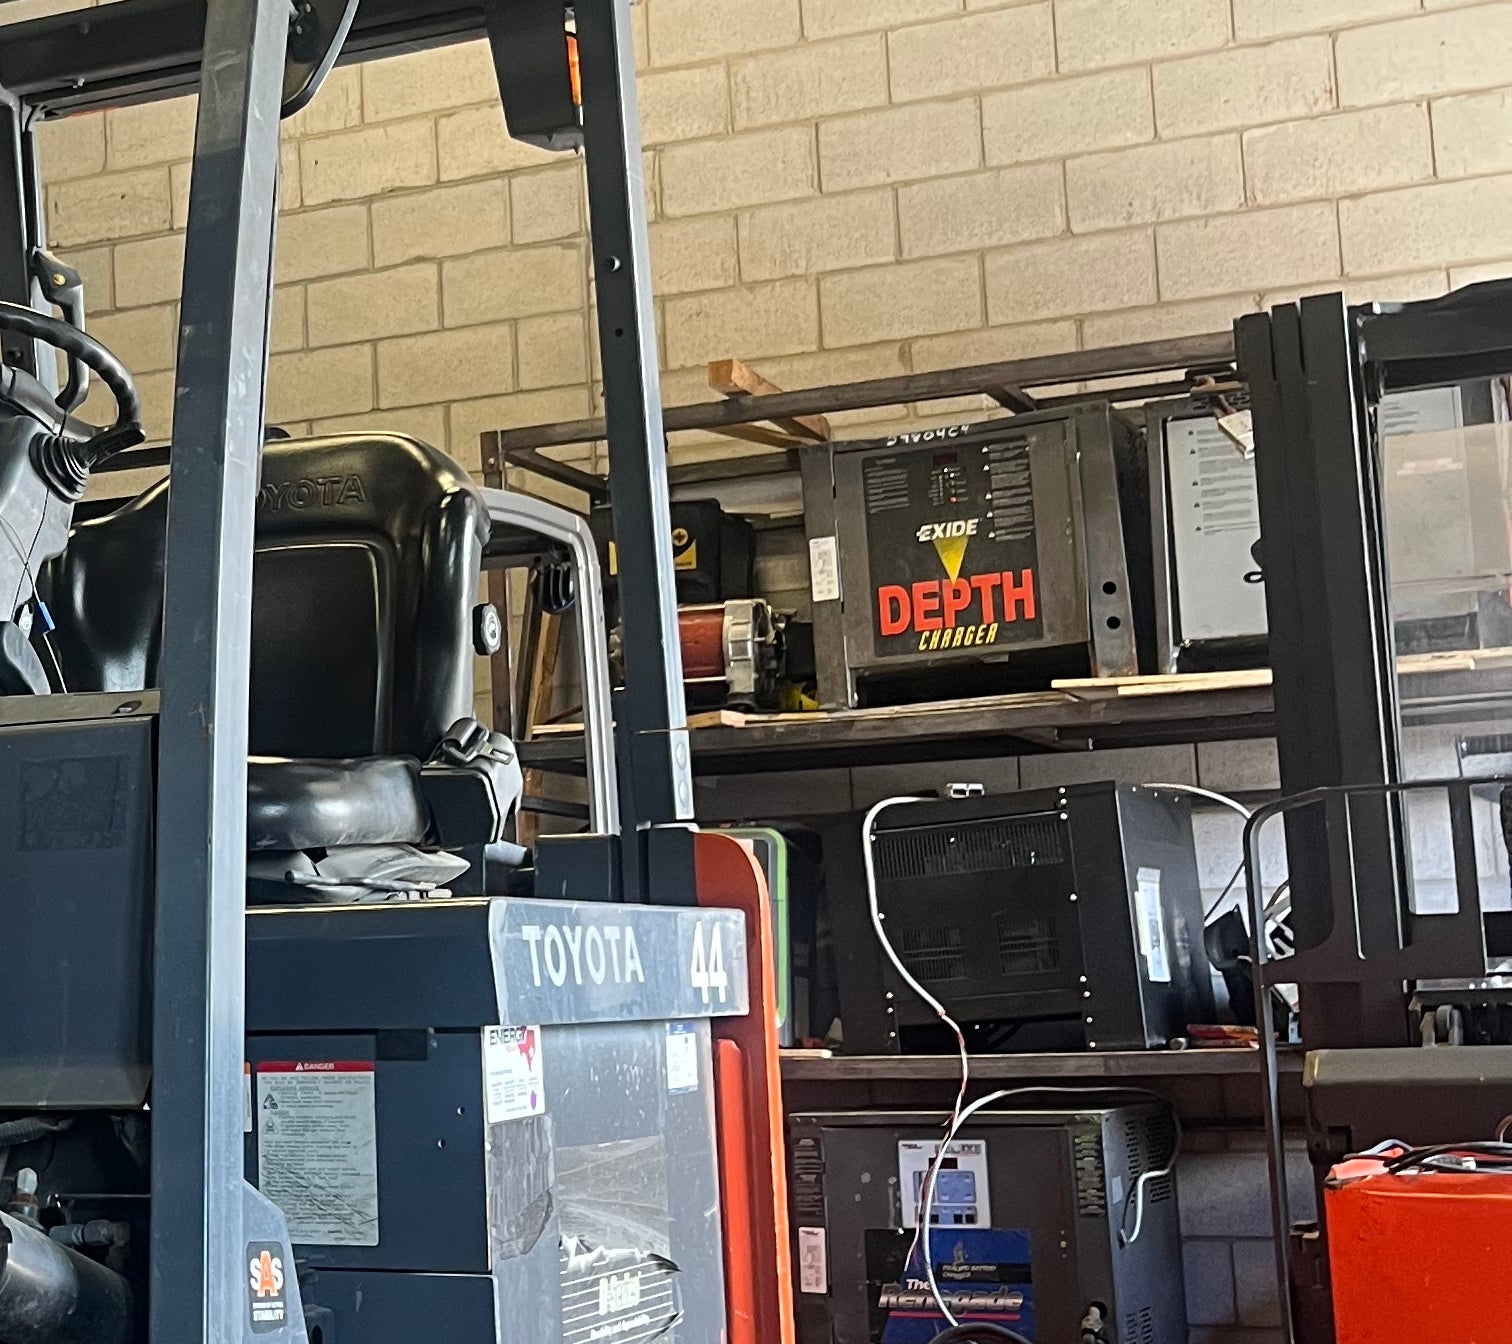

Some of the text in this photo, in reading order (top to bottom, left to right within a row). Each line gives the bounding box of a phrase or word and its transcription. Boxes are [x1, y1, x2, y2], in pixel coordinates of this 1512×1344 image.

[257, 474, 365, 511] YOTA
[916, 518, 979, 543] EXIDE
[878, 568, 1036, 637] DEPTH
[918, 622, 999, 651] CHARGER
[521, 924, 645, 987] TOYOTA
[691, 920, 728, 1004] 44
[304, 1061, 335, 1071] DANGER
[250, 1250, 284, 1297] SAS
[906, 1278, 931, 1290] The
